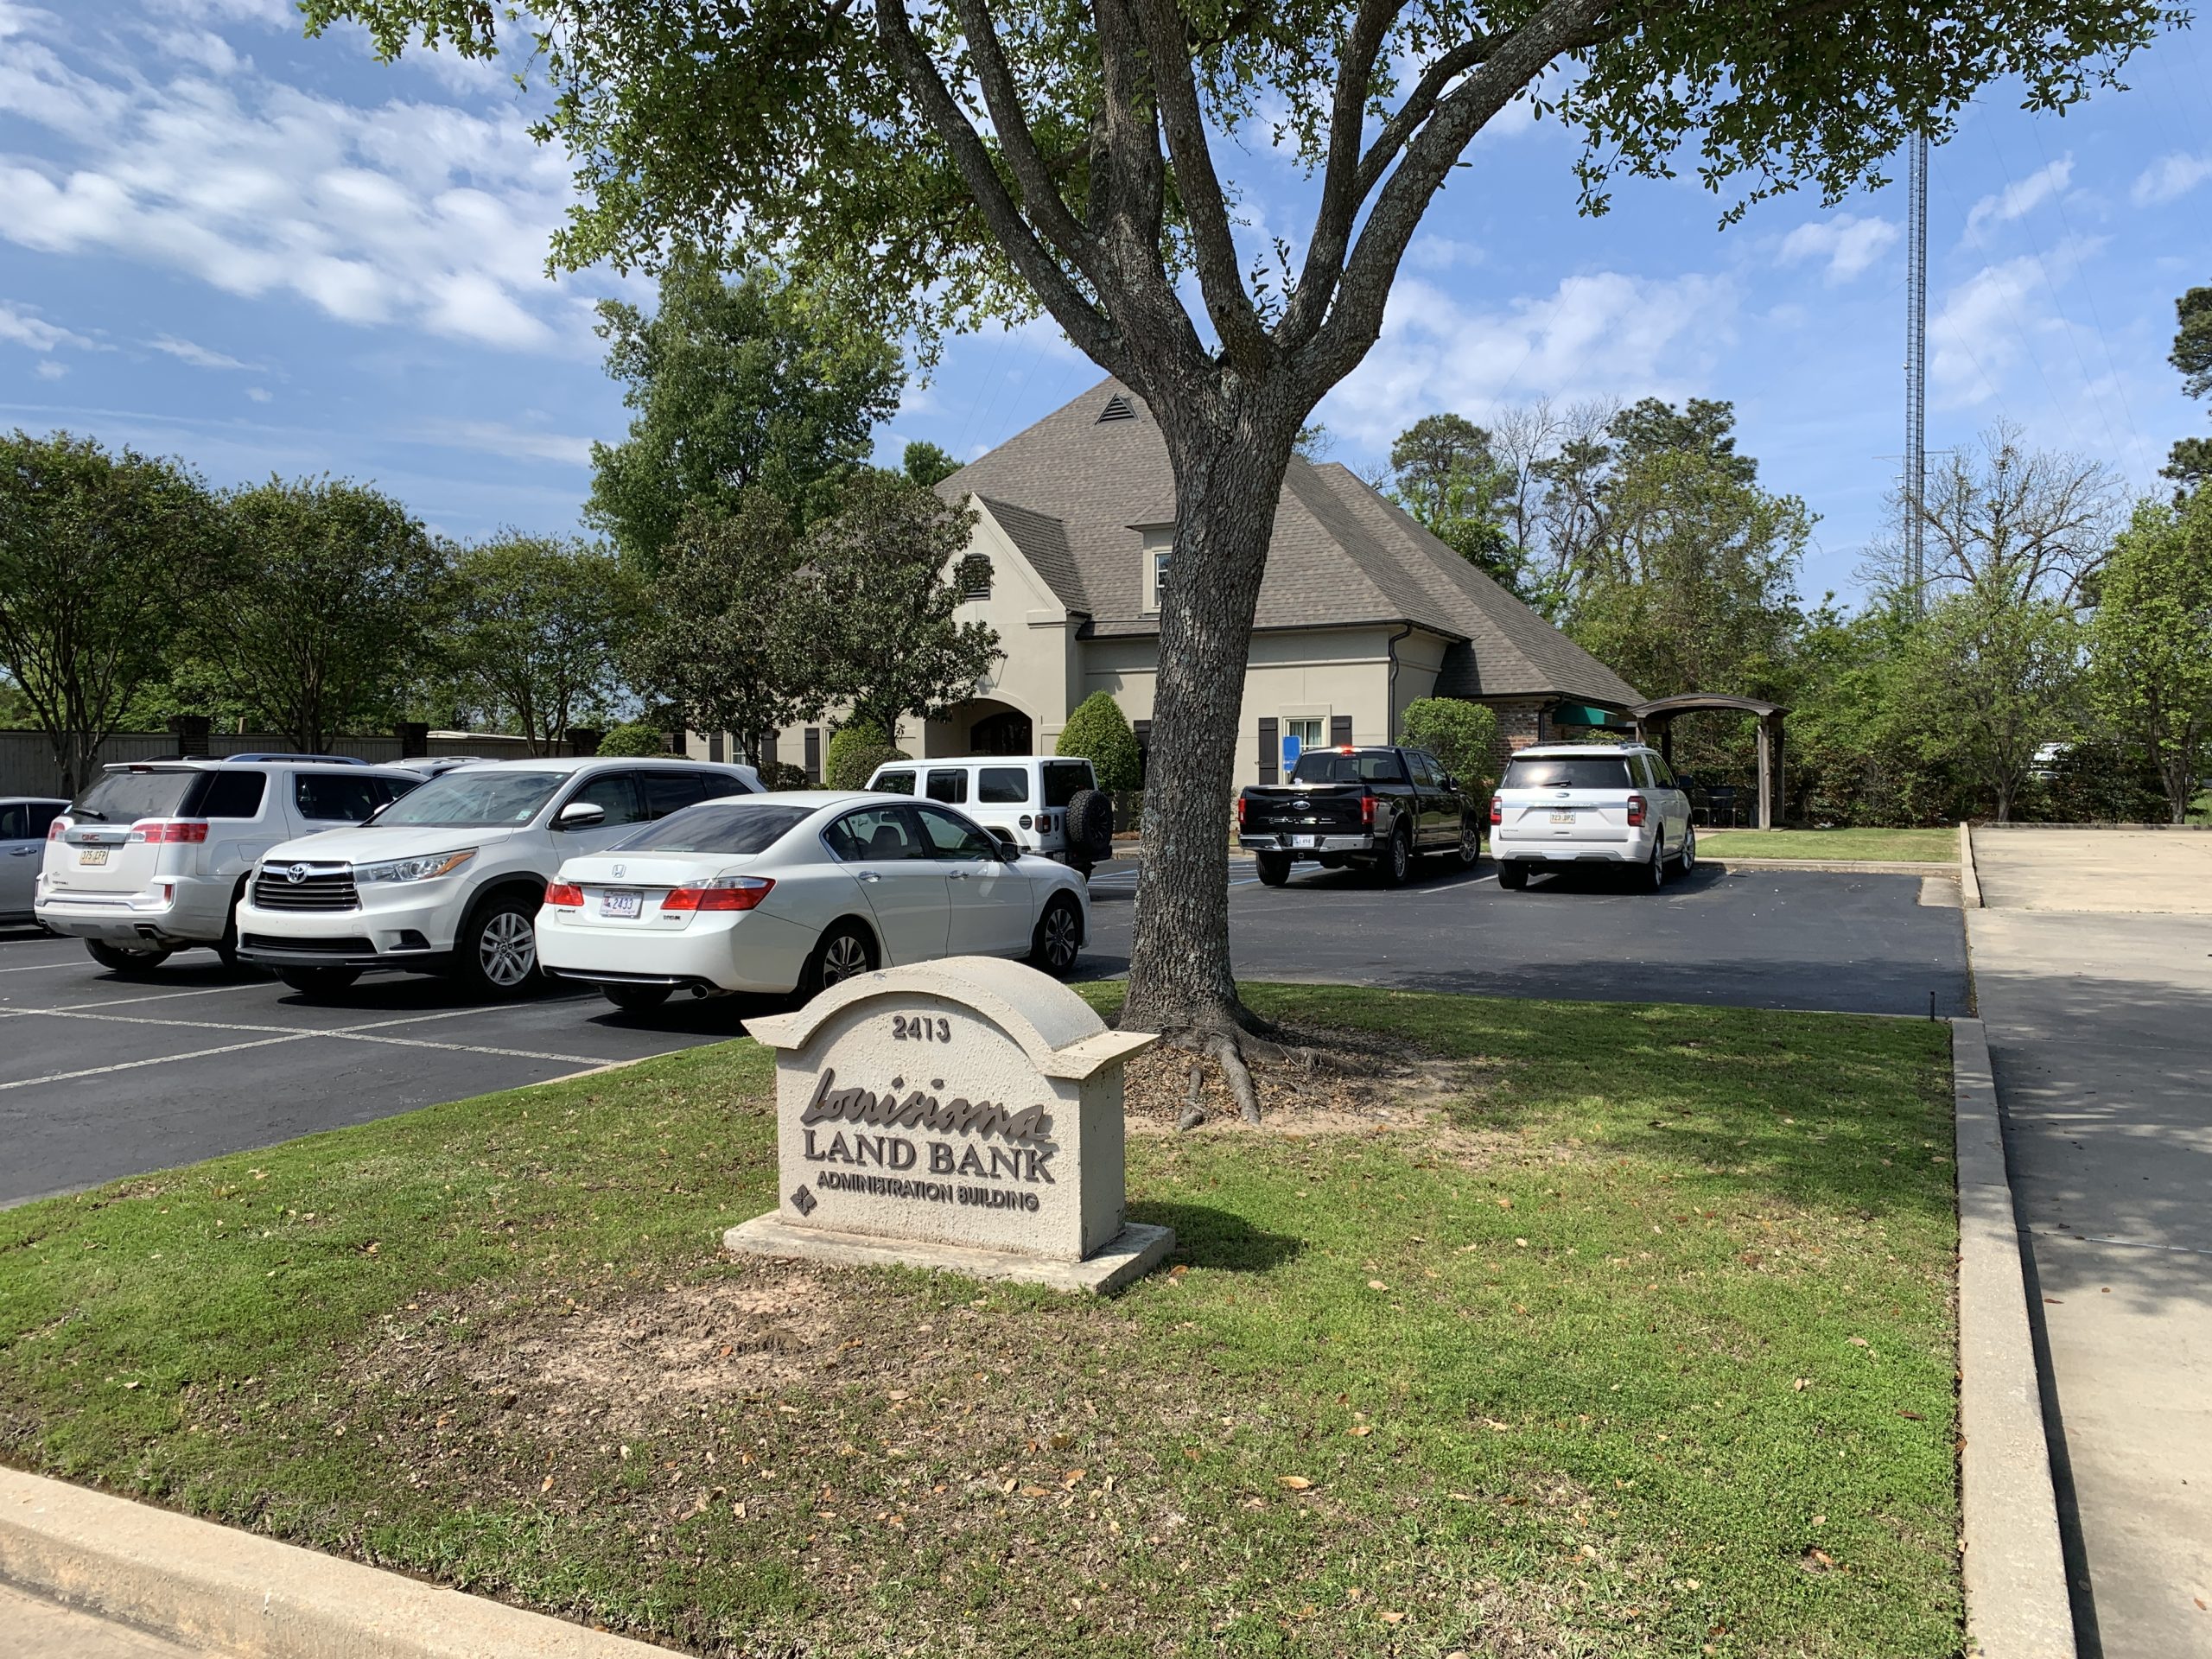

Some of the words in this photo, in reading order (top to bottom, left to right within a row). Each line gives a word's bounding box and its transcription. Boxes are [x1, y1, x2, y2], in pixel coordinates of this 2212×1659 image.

[613, 898, 633, 910] 2433
[892, 1015, 950, 1042] 2413
[800, 1067, 1053, 1141] Louisiana
[804, 1128, 917, 1170] LAND
[928, 1141, 1055, 1183] BANK
[817, 1171, 952, 1203] ADMINISTRATION
[957, 1186, 1039, 1211] BUILDING
